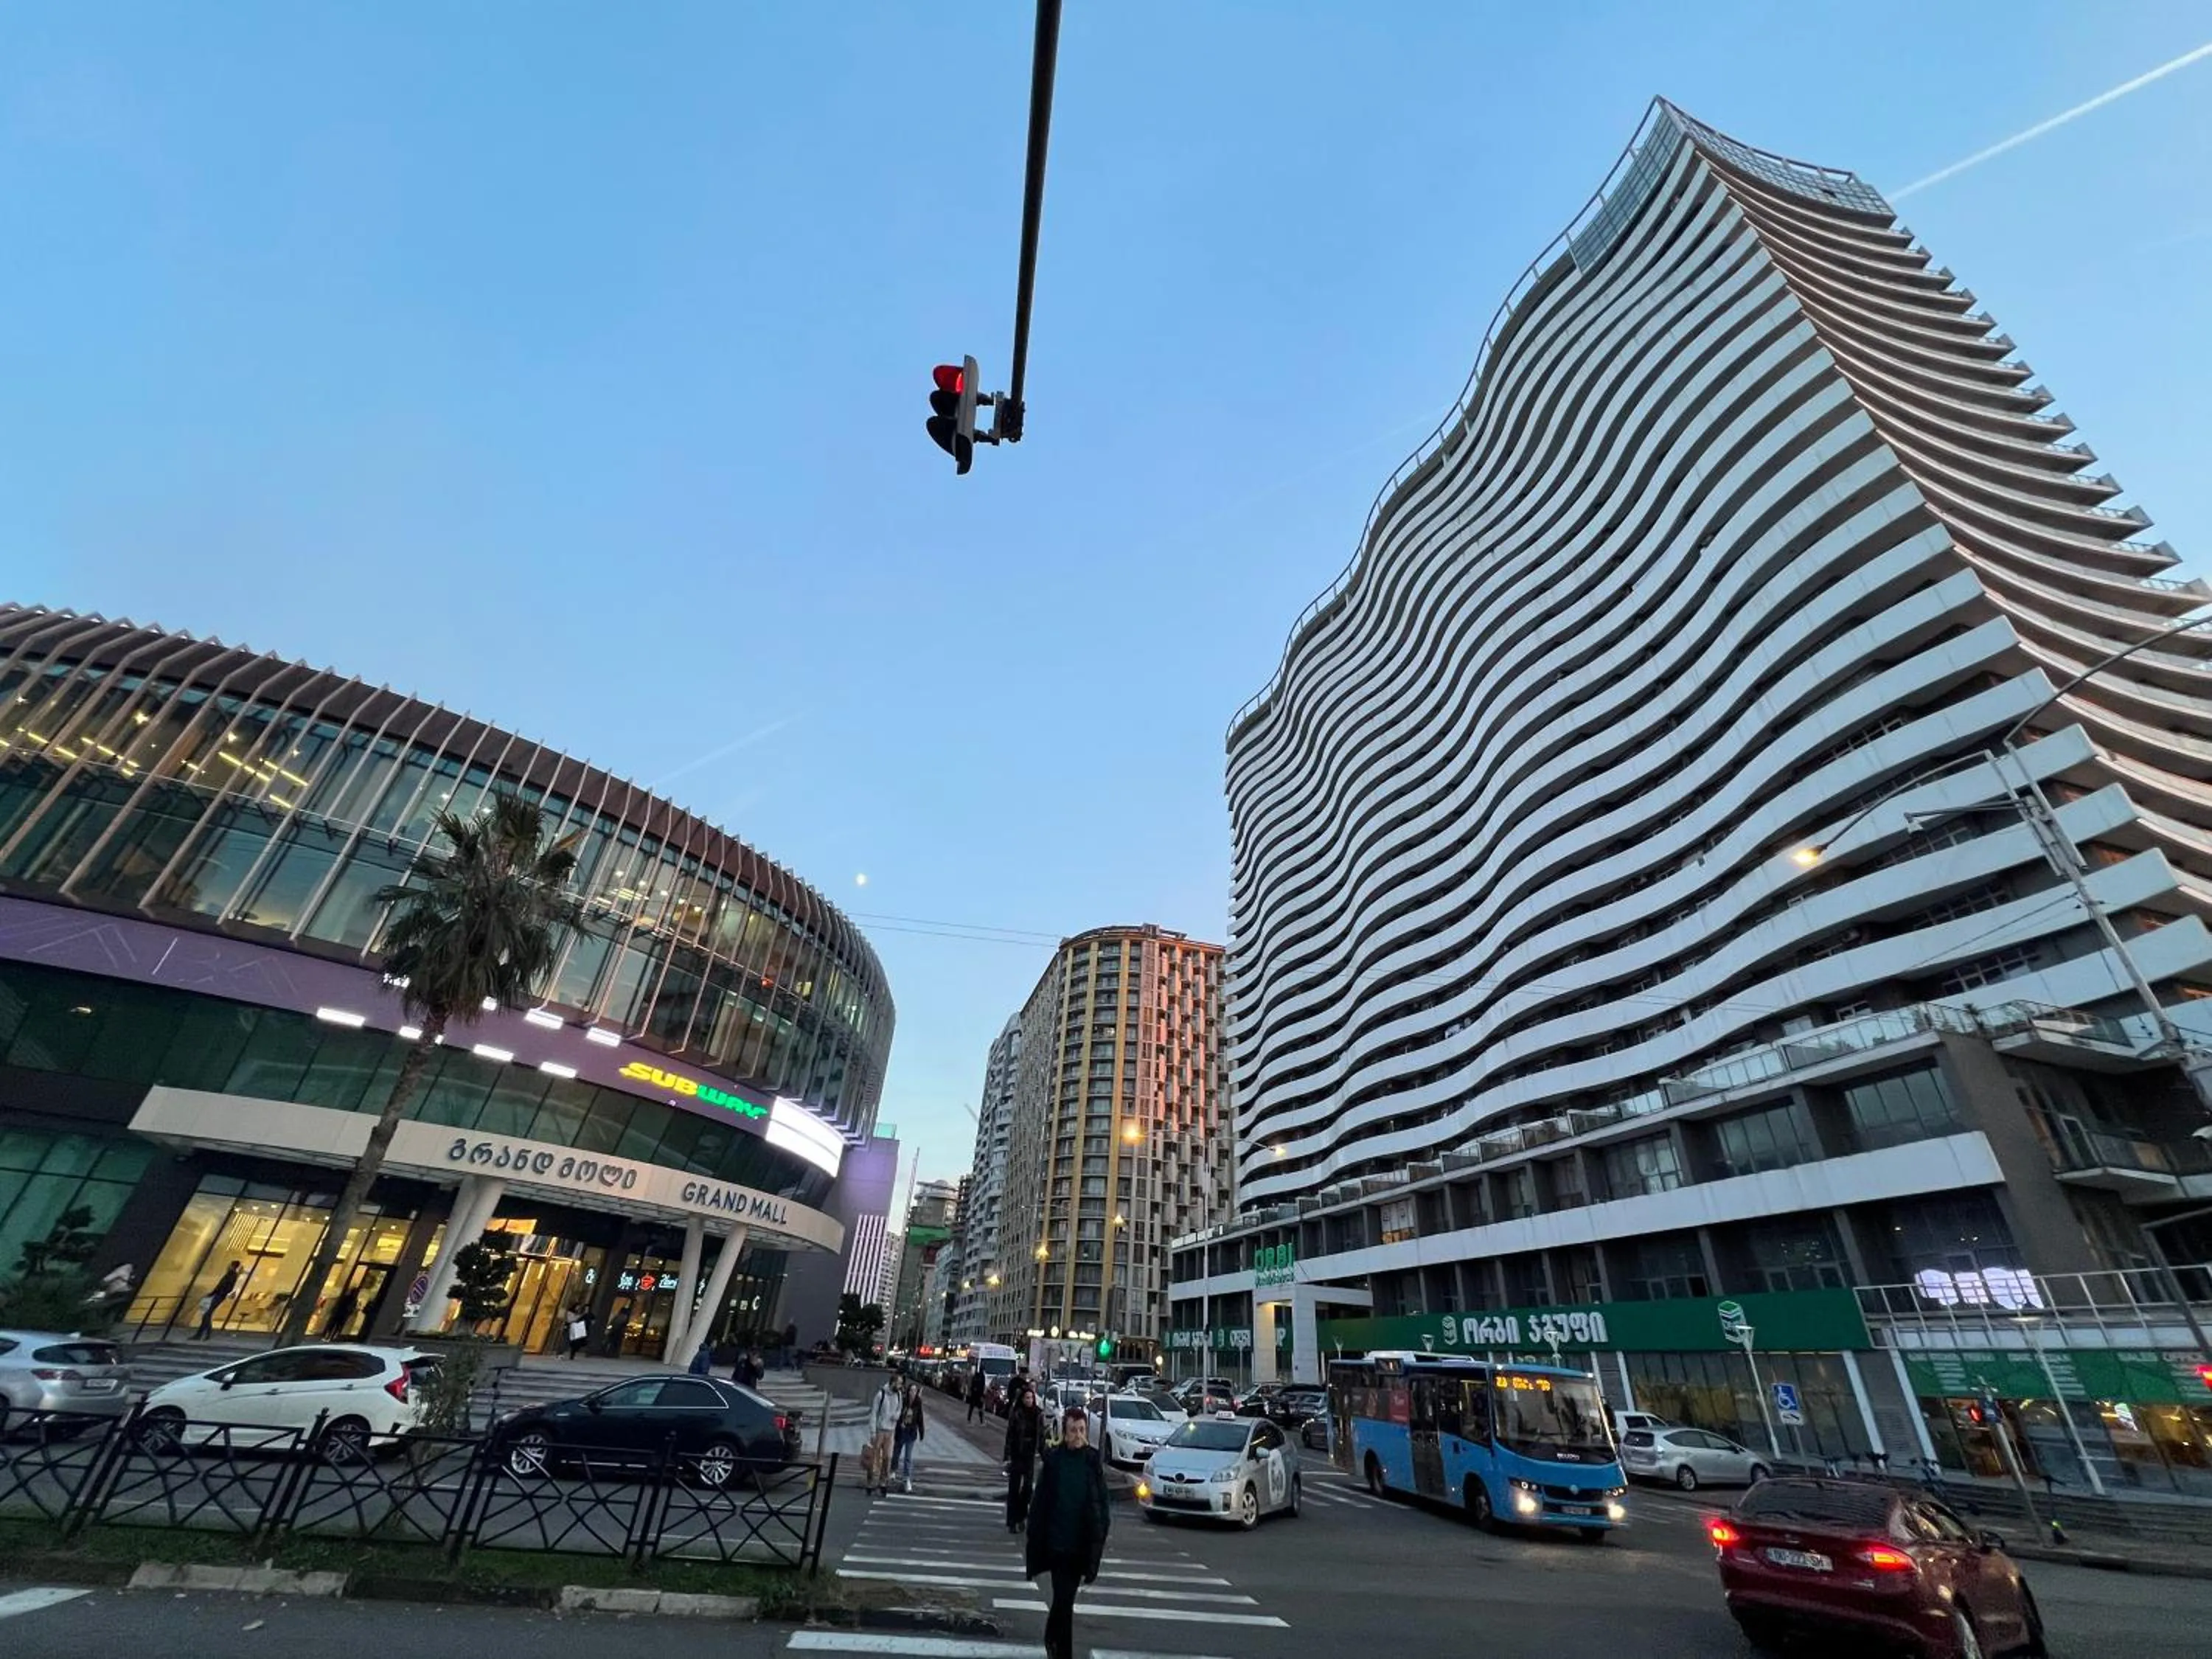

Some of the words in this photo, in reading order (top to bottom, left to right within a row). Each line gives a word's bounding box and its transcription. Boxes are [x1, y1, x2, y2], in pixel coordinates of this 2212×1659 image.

[619, 1062, 768, 1119] SUBWAY
[448, 1138, 554, 1175] გრანდ
[558, 1157, 638, 1189] მოლი
[682, 1181, 747, 1213] GRAND
[748, 1197, 787, 1225] MALL
[1254, 1242, 1293, 1272] ORBI
[1463, 1315, 1521, 1344] ორბი
[1528, 1311, 1609, 1343] ჯგუფი
